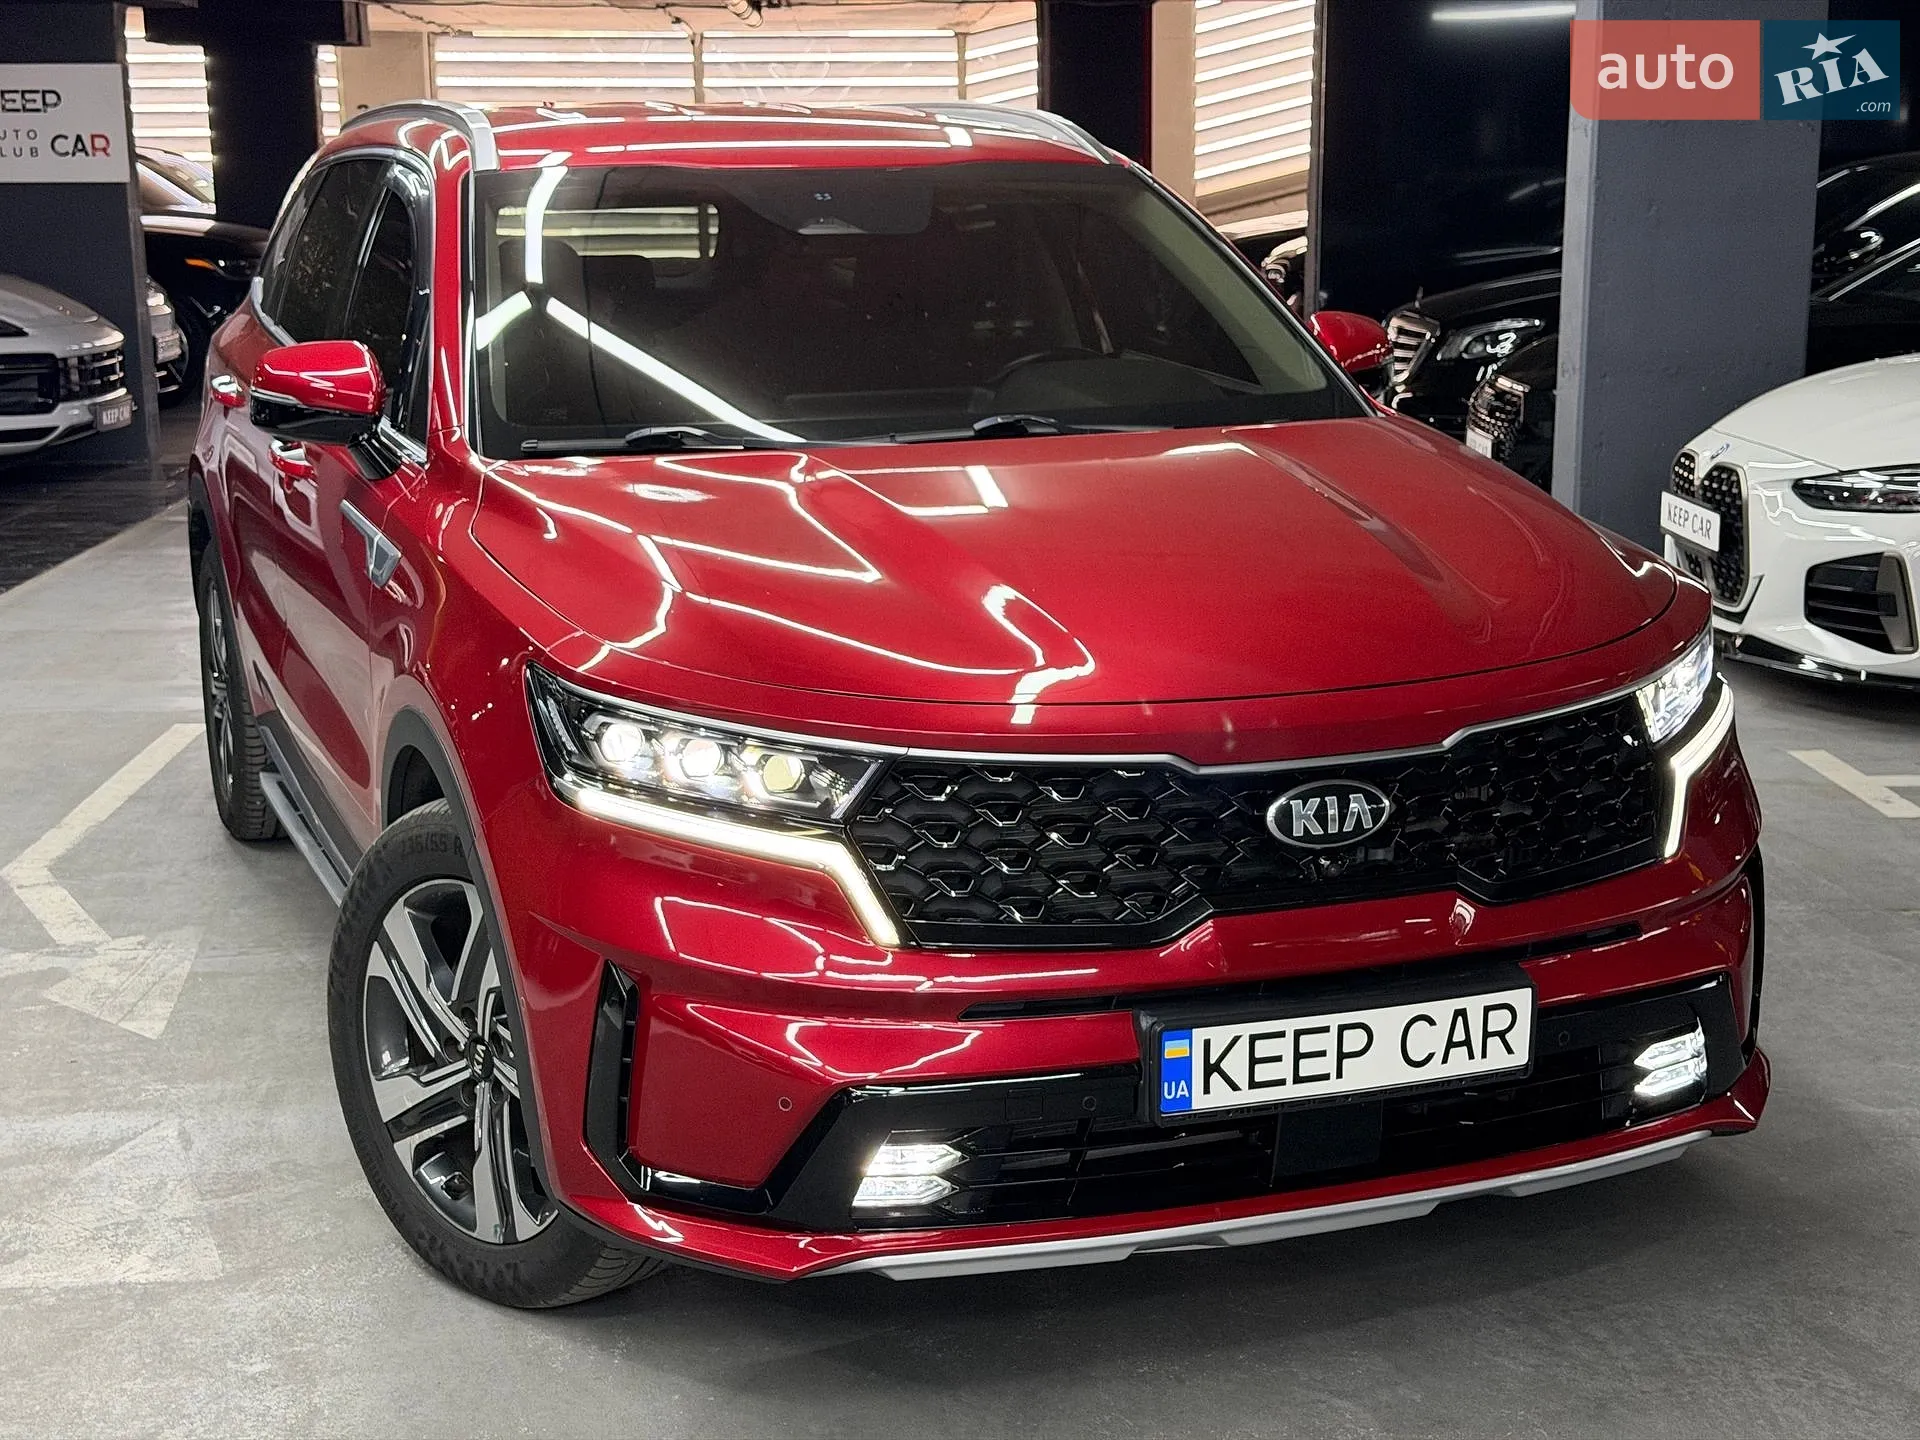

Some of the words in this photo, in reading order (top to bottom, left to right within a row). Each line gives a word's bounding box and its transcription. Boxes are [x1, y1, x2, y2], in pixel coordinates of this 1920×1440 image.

[50, 134, 110, 157] CAR
[1667, 501, 1690, 528] KEEP
[1691, 513, 1712, 540] CAR
[1290, 793, 1373, 836] KIA
[474, 1044, 486, 1075] KIA
[1202, 1022, 1374, 1095] KEEP
[1400, 1002, 1518, 1069] CAR
[1164, 1080, 1189, 1099] UA
